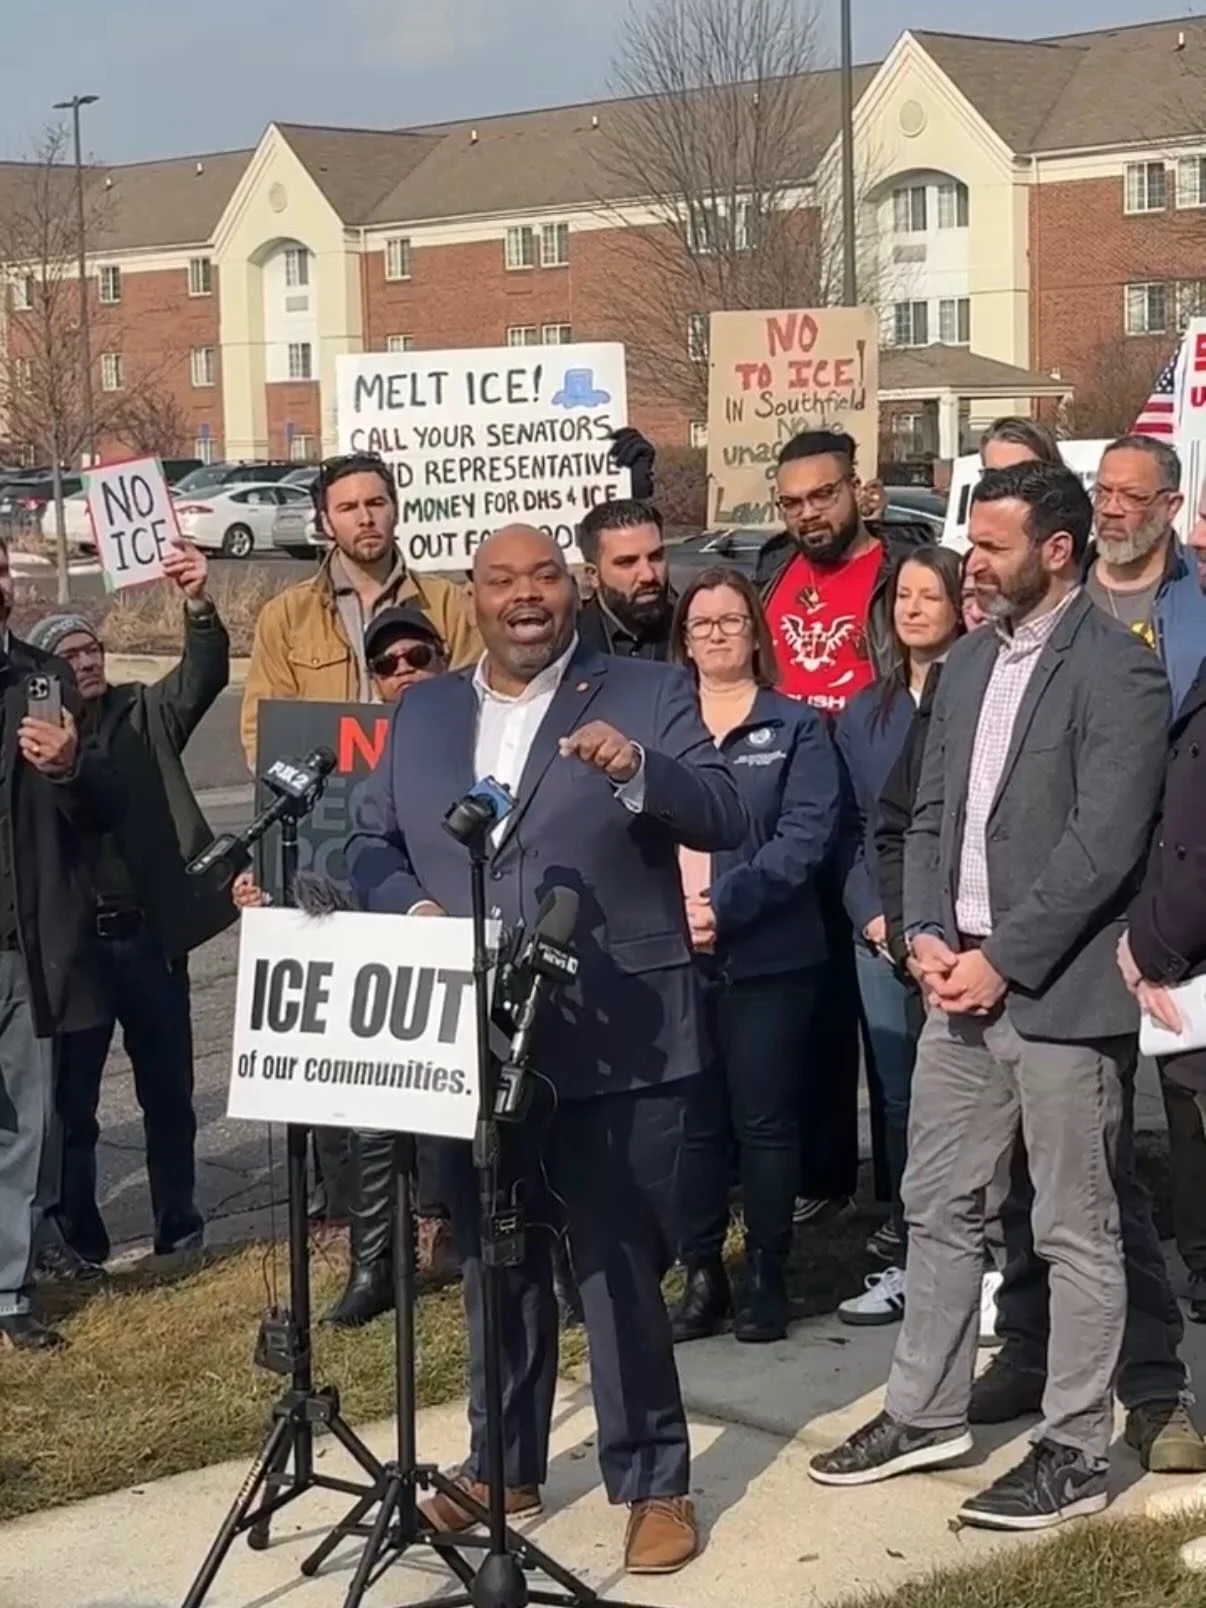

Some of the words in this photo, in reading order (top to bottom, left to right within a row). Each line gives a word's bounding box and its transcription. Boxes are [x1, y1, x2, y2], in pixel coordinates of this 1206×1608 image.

[766, 313, 819, 357] NO
[354, 371, 449, 413] MELT
[467, 365, 543, 406] ICE!
[735, 362, 772, 391] TO
[788, 340, 866, 389] ICE!
[725, 397, 744, 424] IN
[755, 389, 866, 419] Southfield
[351, 426, 409, 453] CALL
[413, 424, 476, 449] YOUR
[487, 414, 614, 447] SENATORS
[425, 451, 621, 485] REPRESENTATIVE
[101, 474, 155, 526] NO
[403, 492, 475, 523] MONEY
[485, 489, 520, 515] FOR
[523, 490, 562, 511] DHS
[582, 484, 617, 509] ICE
[110, 518, 167, 571] ICE
[409, 533, 457, 559] OUT
[338, 716, 391, 773] N
[250, 957, 334, 1035] ICE
[349, 962, 474, 1044] OUT
[237, 1049, 258, 1079] of
[262, 1055, 297, 1081] our
[304, 1056, 472, 1096] communities.
